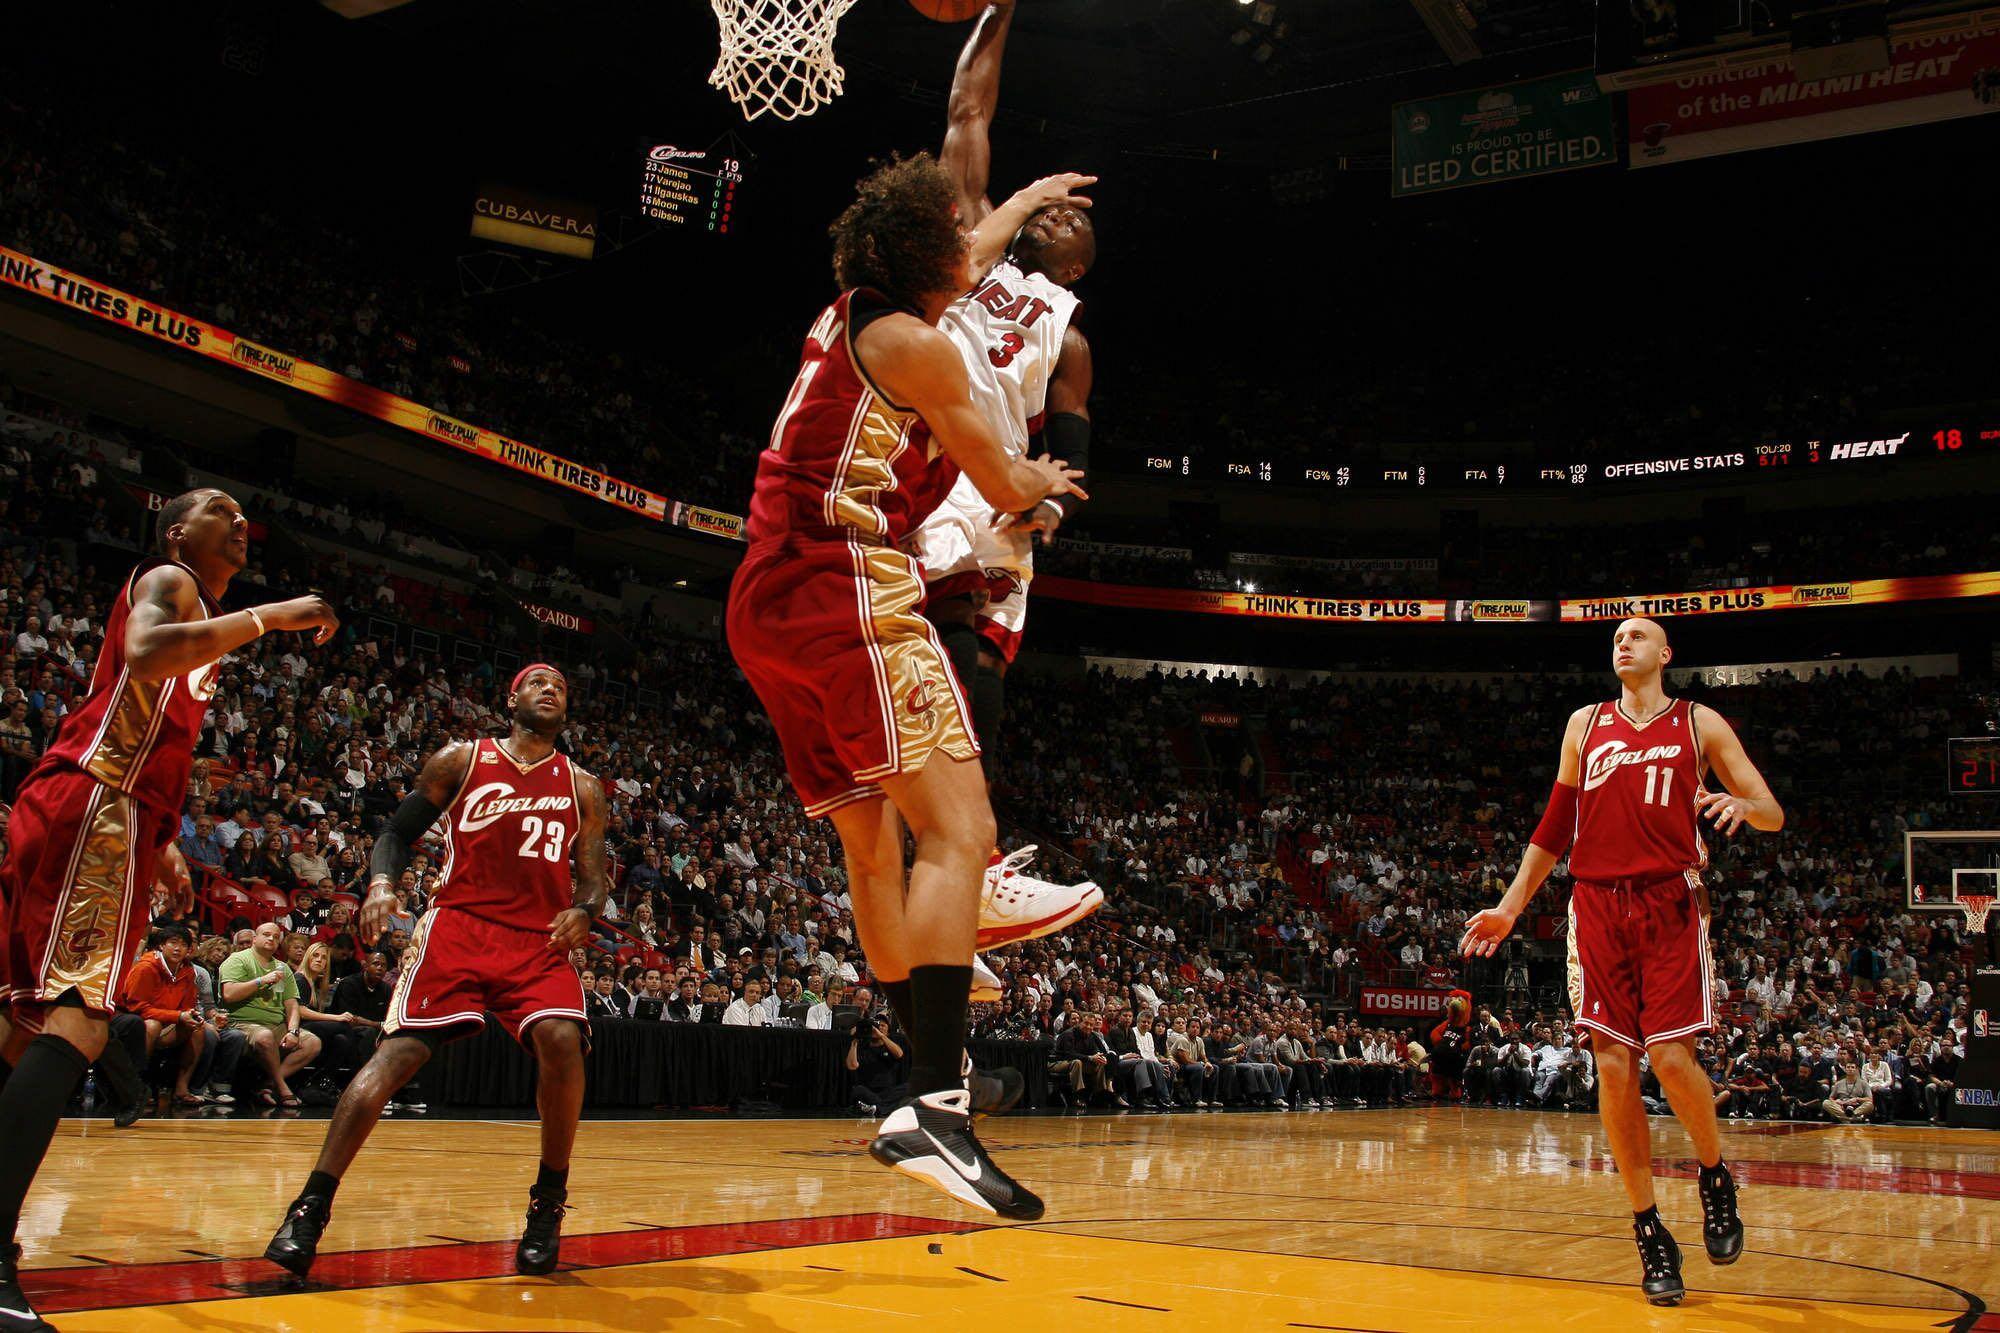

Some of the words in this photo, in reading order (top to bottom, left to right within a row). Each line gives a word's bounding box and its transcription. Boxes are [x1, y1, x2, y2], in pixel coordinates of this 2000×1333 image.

[1679, 97, 1703, 118] of
[1710, 93, 1751, 113] the
[1759, 74, 1864, 106] MIAMI
[1869, 46, 1966, 88] HEAT
[1452, 144, 1462, 155] IS
[1467, 135, 1511, 153] PROUD
[1516, 132, 1534, 143] TO
[1537, 128, 1553, 141] BE
[650, 145, 706, 160] CLEVELAND
[646, 161, 657, 171] 23
[659, 165, 689, 179] James
[724, 159, 739, 172] 19
[1402, 160, 1461, 188] LEED
[1472, 136, 1607, 177] CERTIFIED.
[644, 173, 656, 182] 17
[656, 175, 692, 191] Varejao
[726, 171, 742, 183] PTS
[641, 195, 652, 204] 15
[652, 198, 679, 210] Moon
[643, 184, 653, 193] 11
[655, 186, 699, 204] Ilgauskas
[475, 198, 596, 238] CUBAVERA
[642, 206, 646, 215] 1
[650, 208, 684, 223] Gibson
[49, 273, 128, 320] TIRES
[136, 306, 200, 347] PLUS
[240, 342, 269, 363] TIRES
[269, 354, 293, 371] PLUS
[988, 333, 1024, 367] 3
[435, 417, 458, 433] TIRES
[457, 427, 478, 441] PLUS
[1807, 441, 1821, 450] TF
[1830, 432, 1910, 460] HEAT
[1932, 428, 1963, 451] 18
[1147, 457, 1172, 469] FGM
[1182, 456, 1189, 466] 6
[1809, 450, 1820, 463] 3
[1228, 464, 1251, 474] FGA
[1259, 462, 1271, 472] 14
[1306, 469, 1331, 481] FG%
[1337, 467, 1349, 477] 42
[1384, 471, 1407, 481] FTM
[1418, 466, 1425, 475] 6
[1465, 471, 1487, 480] FTA
[1498, 466, 1505, 475] 6
[1541, 470, 1565, 480] FT%
[1569, 464, 1588, 475] 100
[1604, 458, 1690, 478] OFFENSIVE
[1693, 453, 1745, 470] STATS
[499, 440, 547, 473] THINK
[552, 459, 600, 491] TIRES
[606, 481, 647, 509] PLUS
[1259, 472, 1271, 481] 16
[1337, 477, 1349, 486] 37
[1418, 476, 1425, 485] 6
[1498, 475, 1505, 485] 7
[1571, 474, 1584, 484] 85
[696, 512, 718, 524] TIRES
[718, 517, 738, 529] PLUS
[1800, 586, 1826, 598] TIRES
[1826, 584, 1850, 596] PLUS
[1245, 596, 1298, 615] THINK
[1304, 600, 1362, 617] TIRES
[1369, 602, 1421, 617] PLUS
[1480, 604, 1502, 614] TIRES
[1504, 604, 1526, 614] PLUS
[1579, 602, 1635, 618] THINK
[1641, 596, 1702, 615] TIRES
[1709, 593, 1764, 610] PLUS
[1584, 740, 1681, 791] CLEVELAND
[1644, 765, 1674, 807] 11
[459, 782, 571, 832] CLEVELAND
[518, 816, 565, 863] 23
[1963, 1088, 2000, 1106] NBA.
